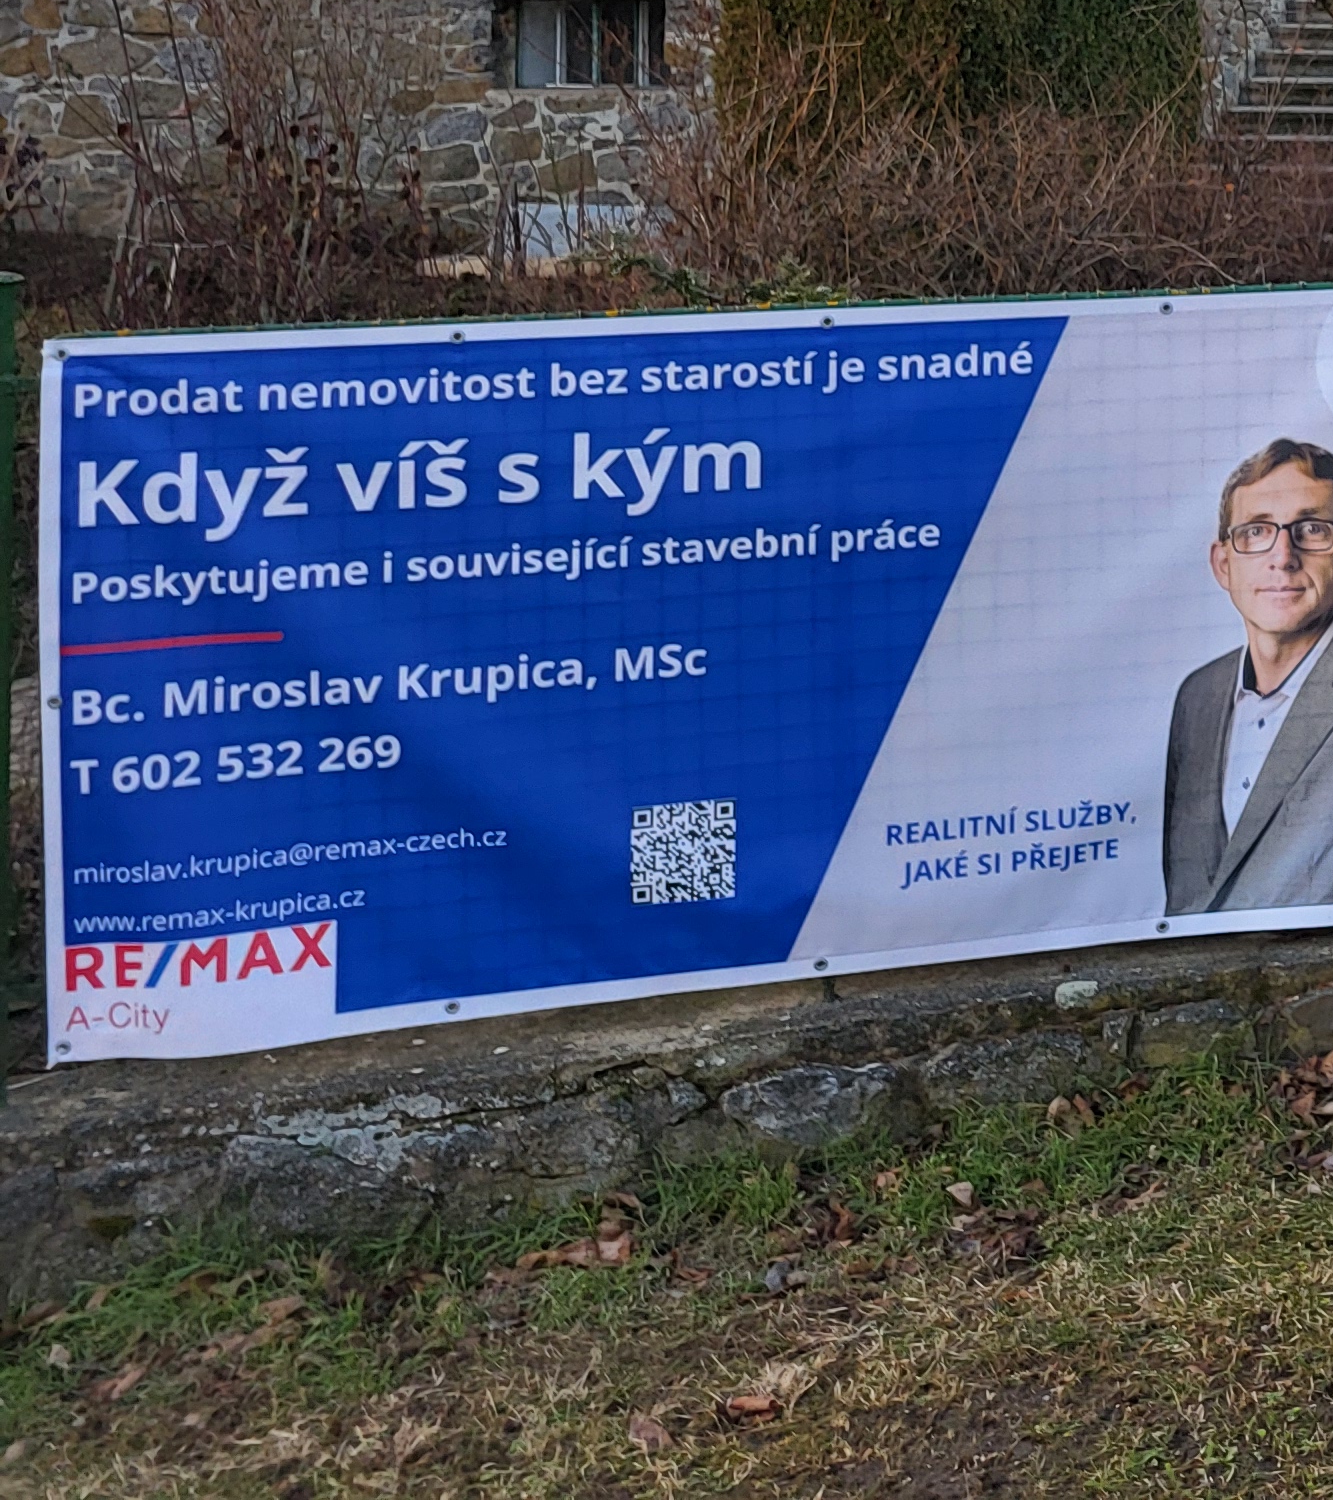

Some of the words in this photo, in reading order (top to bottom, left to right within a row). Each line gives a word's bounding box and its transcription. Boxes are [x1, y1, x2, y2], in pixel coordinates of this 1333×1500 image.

[74, 378, 243, 418] Prodat
[259, 368, 536, 411] nemovitost
[551, 362, 628, 396] bez
[641, 351, 819, 393] starostí
[823, 351, 865, 393] je
[878, 341, 1034, 381] snadné
[77, 447, 309, 542] Když
[337, 438, 469, 512] víš
[499, 450, 540, 504] s
[573, 428, 762, 516] kým
[71, 559, 368, 606] Poskytujeme
[382, 551, 394, 583] i
[407, 537, 629, 582] související
[642, 524, 821, 568] stavební
[831, 519, 940, 562] práce
[71, 689, 145, 726] Bc.
[163, 670, 382, 718] Miroslav
[399, 654, 597, 703] Krupica,
[614, 643, 708, 683] MSc
[70, 759, 99, 795] T
[111, 751, 201, 794] 602
[216, 740, 303, 783] 532
[318, 734, 401, 773] 269
[886, 806, 1018, 846] REALITNÍ
[1025, 800, 1137, 832] SLUŽBY,
[73, 828, 507, 885] miroslav.krupica@remax-czech.cz
[900, 850, 968, 890] JAKÉ
[977, 853, 1000, 875] SI
[1012, 842, 1119, 872] PŘEJETE
[73, 888, 365, 933] www.remax-krupica.cz
[65, 922, 332, 992] RE/MAX
[66, 1002, 170, 1034] A-City
